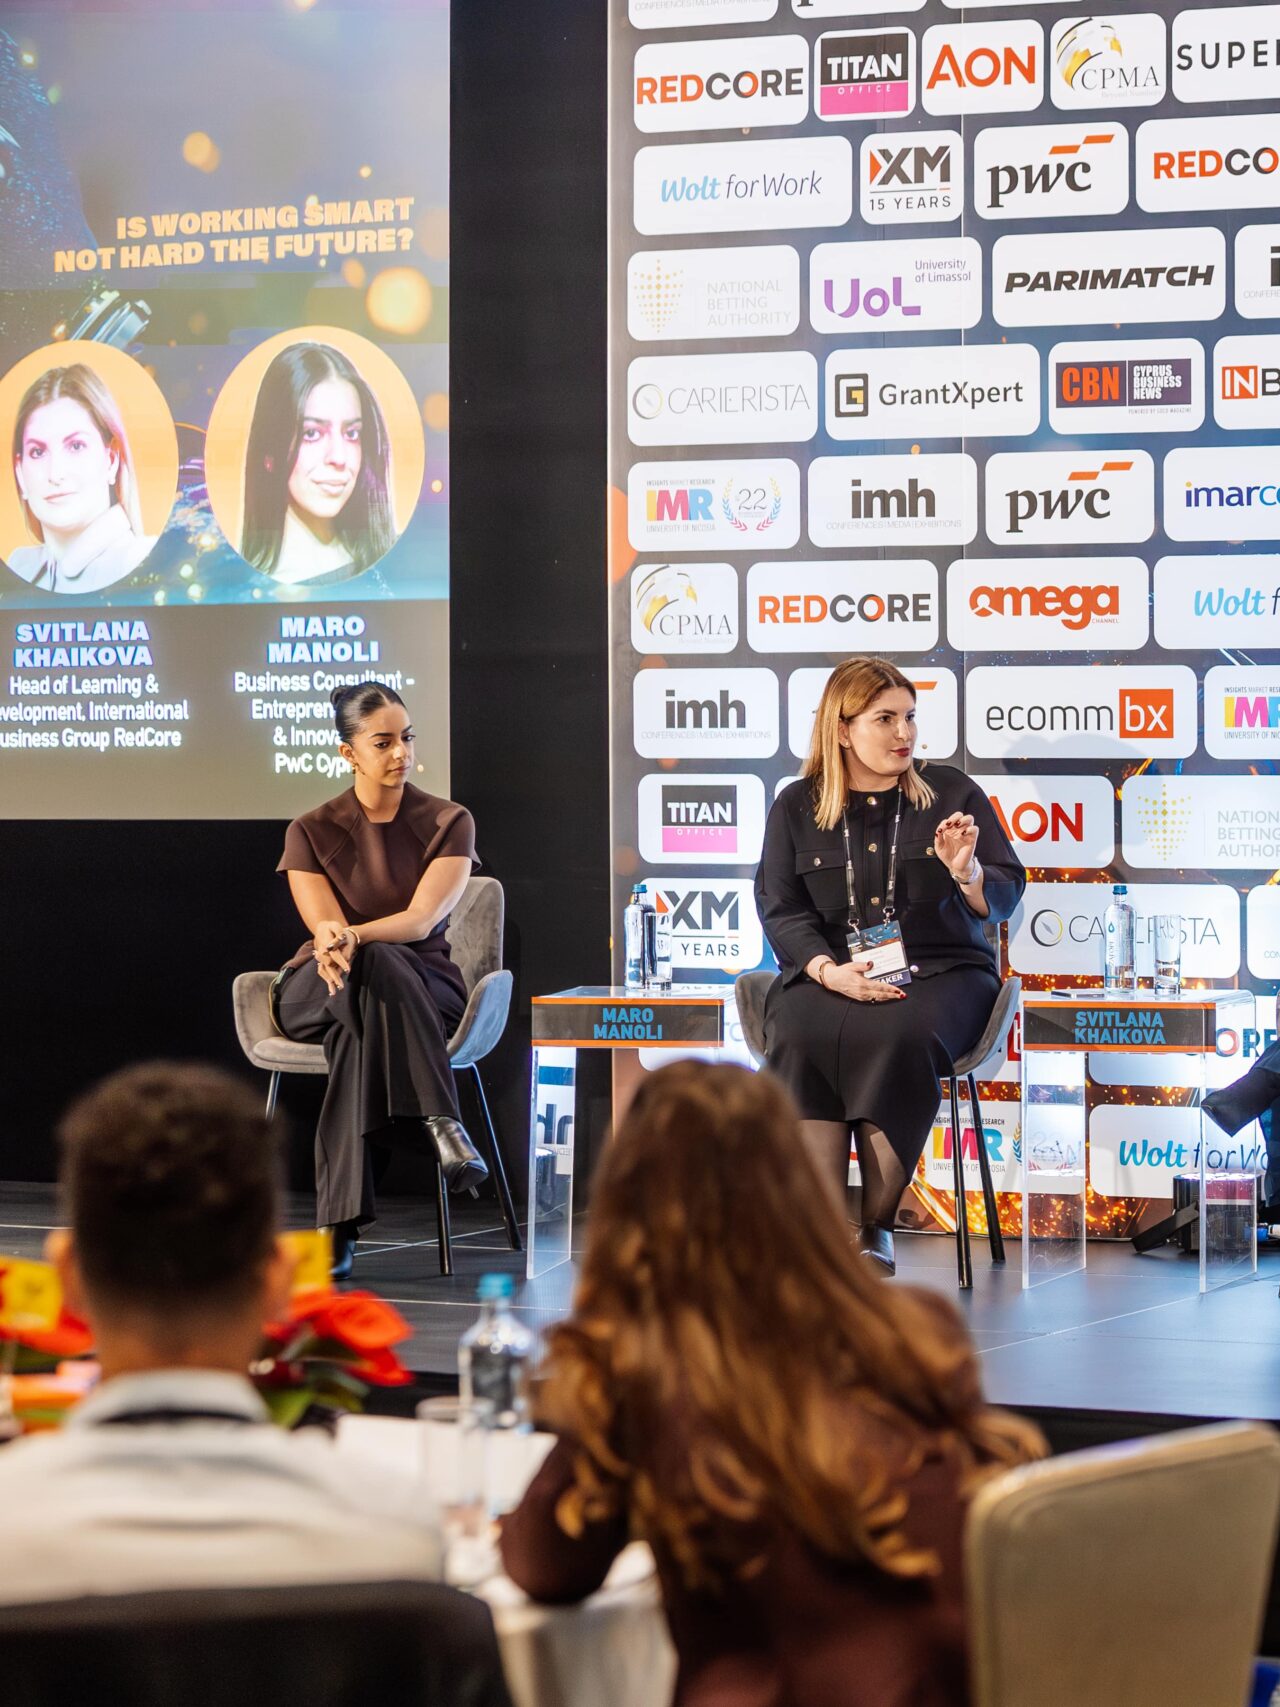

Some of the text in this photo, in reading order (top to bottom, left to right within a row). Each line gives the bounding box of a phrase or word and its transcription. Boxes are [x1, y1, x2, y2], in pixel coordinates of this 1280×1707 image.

[827, 53, 903, 81] TITAN
[926, 44, 1036, 90] AON
[1081, 66, 1160, 91] CPMA
[636, 68, 804, 105] REDCORE
[838, 84, 892, 96] OFFICE
[872, 145, 951, 185] XM
[660, 170, 822, 203] Wolt for Work
[986, 161, 1092, 208] pwc
[870, 195, 952, 211] 15 YEARS
[117, 196, 414, 240] IS WORKING SMART
[54, 228, 415, 273] NOT HARD THE FUTURE?
[915, 259, 967, 273] University
[915, 270, 971, 283] of Limassol
[707, 279, 783, 294] NATIONAL
[1005, 264, 1215, 293] PARIMATCH
[707, 296, 768, 310] BETTING
[707, 311, 791, 327] AUTHORITY
[1133, 365, 1172, 377] CYPRUS
[1133, 376, 1182, 388] BUSINESS
[879, 381, 1024, 411] GrantXpert
[1062, 367, 1120, 402] CBN
[1133, 387, 1162, 400] NEWS
[646, 488, 714, 522] IMR
[738, 488, 767, 511] 22
[851, 479, 936, 519] imh
[1005, 487, 1111, 533] pwc
[758, 593, 932, 624] REDCORE
[969, 585, 1119, 630] omega
[1194, 586, 1265, 617] Wolt
[16, 620, 150, 643] SVITLANA
[281, 615, 366, 638] MARO
[658, 613, 734, 636] CPMA
[14, 645, 153, 668] KHAIKOVA
[268, 640, 379, 664] MANOLI
[9, 673, 160, 699] Head of Learning &
[234, 671, 310, 693] Business
[0, 699, 189, 726] velopment, International
[252, 698, 336, 723] Entrepren
[665, 689, 746, 729] imh
[61, 727, 110, 752] Group
[114, 726, 182, 747] RedCore
[273, 725, 342, 747] & Innov
[1224, 731, 1260, 740] UNIVERSITY
[1261, 731, 1269, 739] OF
[275, 752, 350, 778] PwC Cyp
[667, 802, 732, 824] TITAN
[677, 827, 724, 836] OFFICE
[656, 891, 739, 930] XM
[681, 943, 740, 957] YEARS
[602, 1007, 654, 1023] MARO
[1075, 1011, 1164, 1028] SVITLANA
[593, 1024, 663, 1040] MANOLI
[1074, 1028, 1166, 1045] KHAIKOVA
[1120, 1138, 1189, 1168] Wolt
